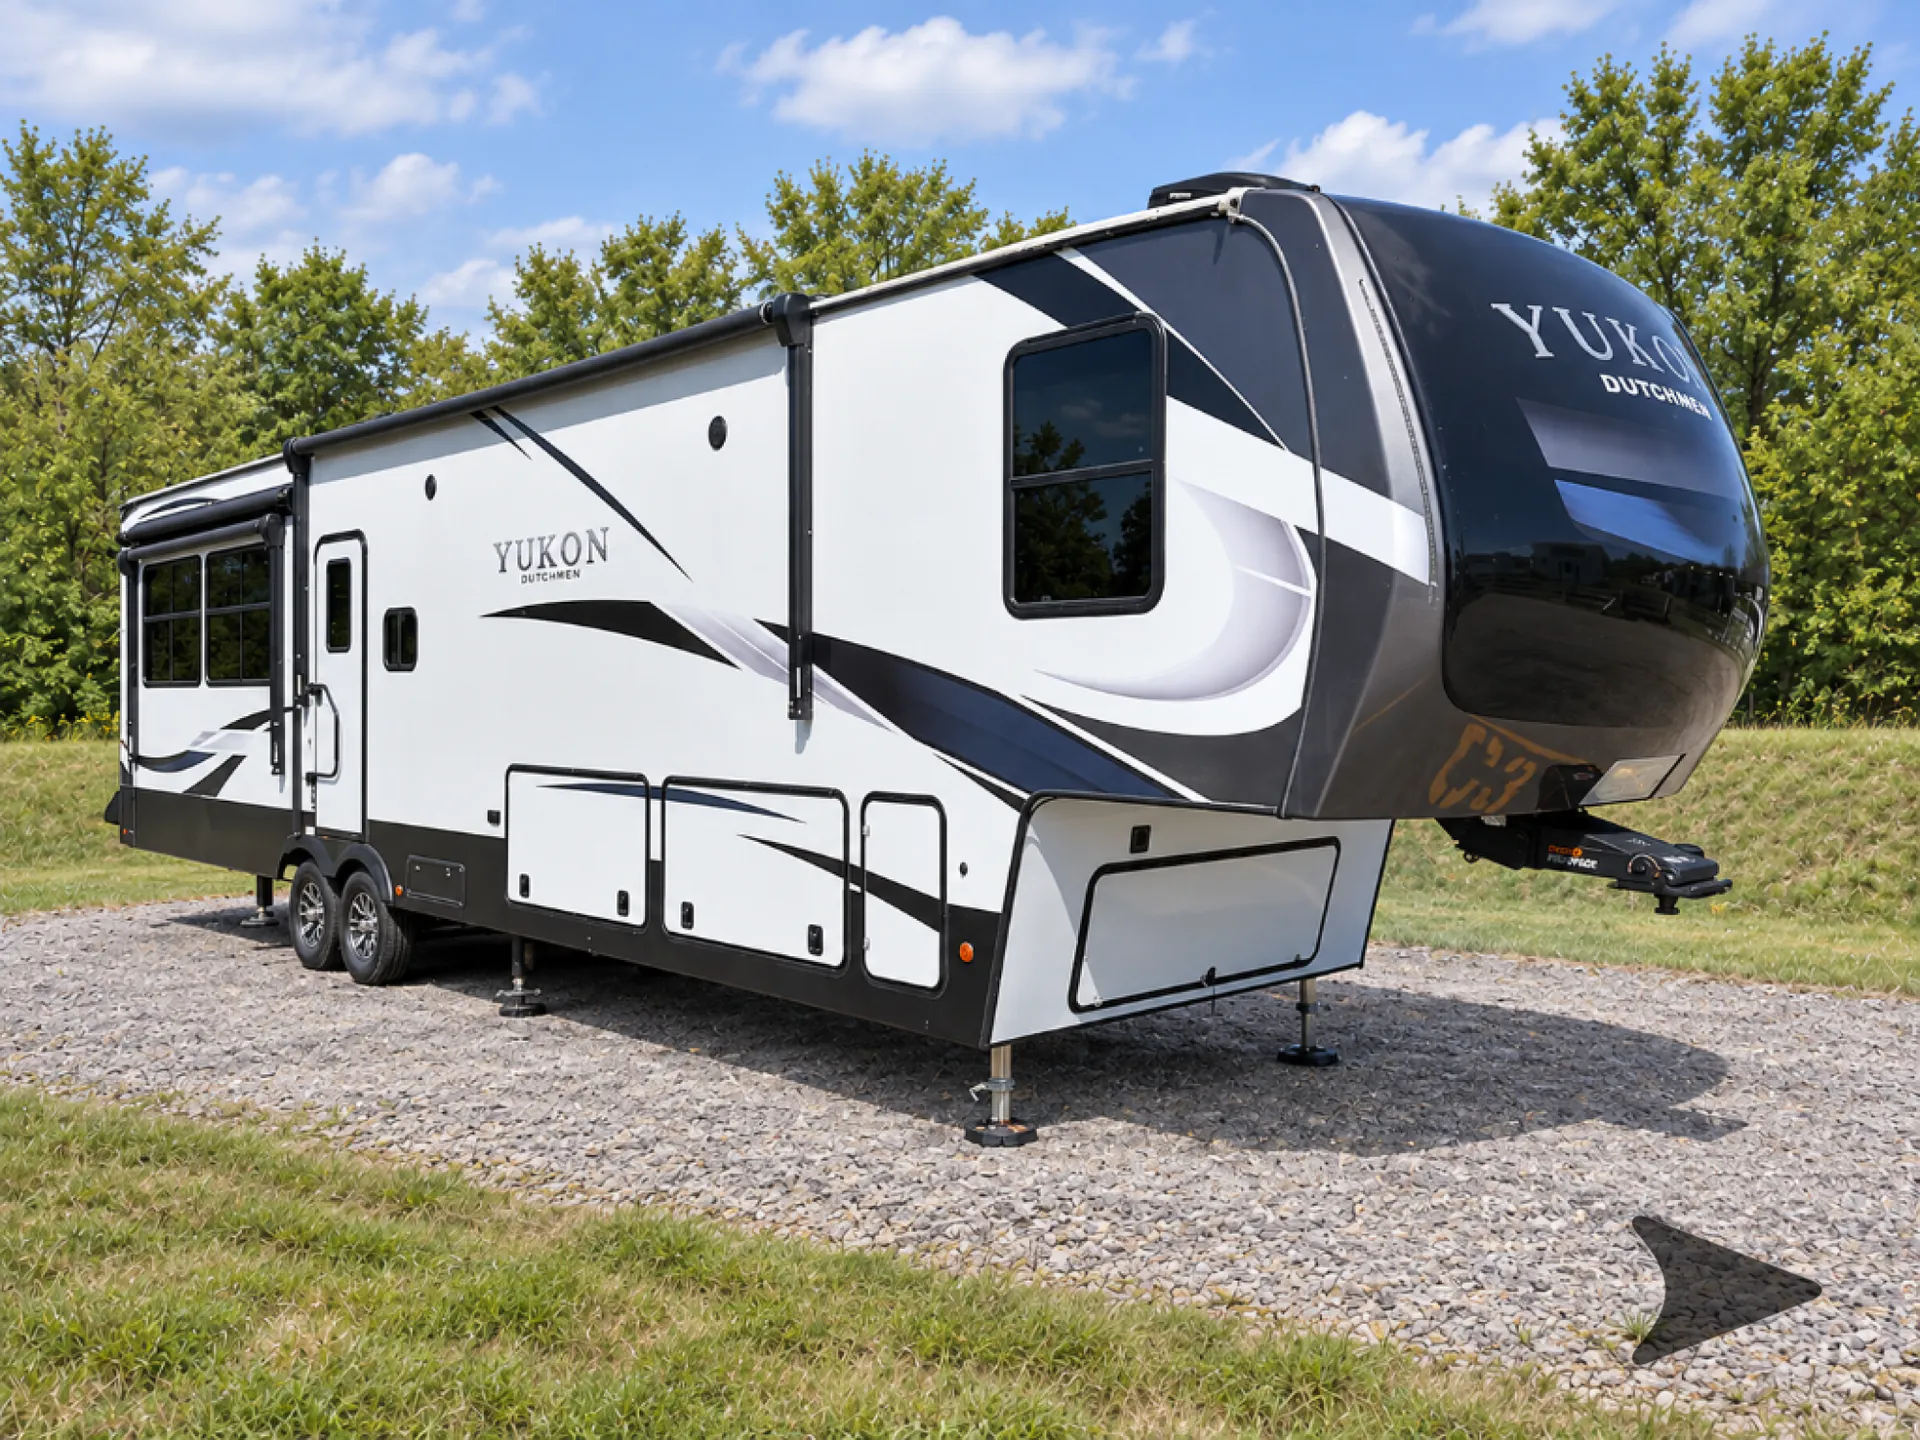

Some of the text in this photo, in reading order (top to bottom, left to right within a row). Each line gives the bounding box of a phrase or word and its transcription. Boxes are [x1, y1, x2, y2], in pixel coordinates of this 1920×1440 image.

[1599, 373, 1712, 420] DUTCHMEN
[493, 526, 609, 573] YUKON
[520, 569, 581, 584] DUTCHMEN
